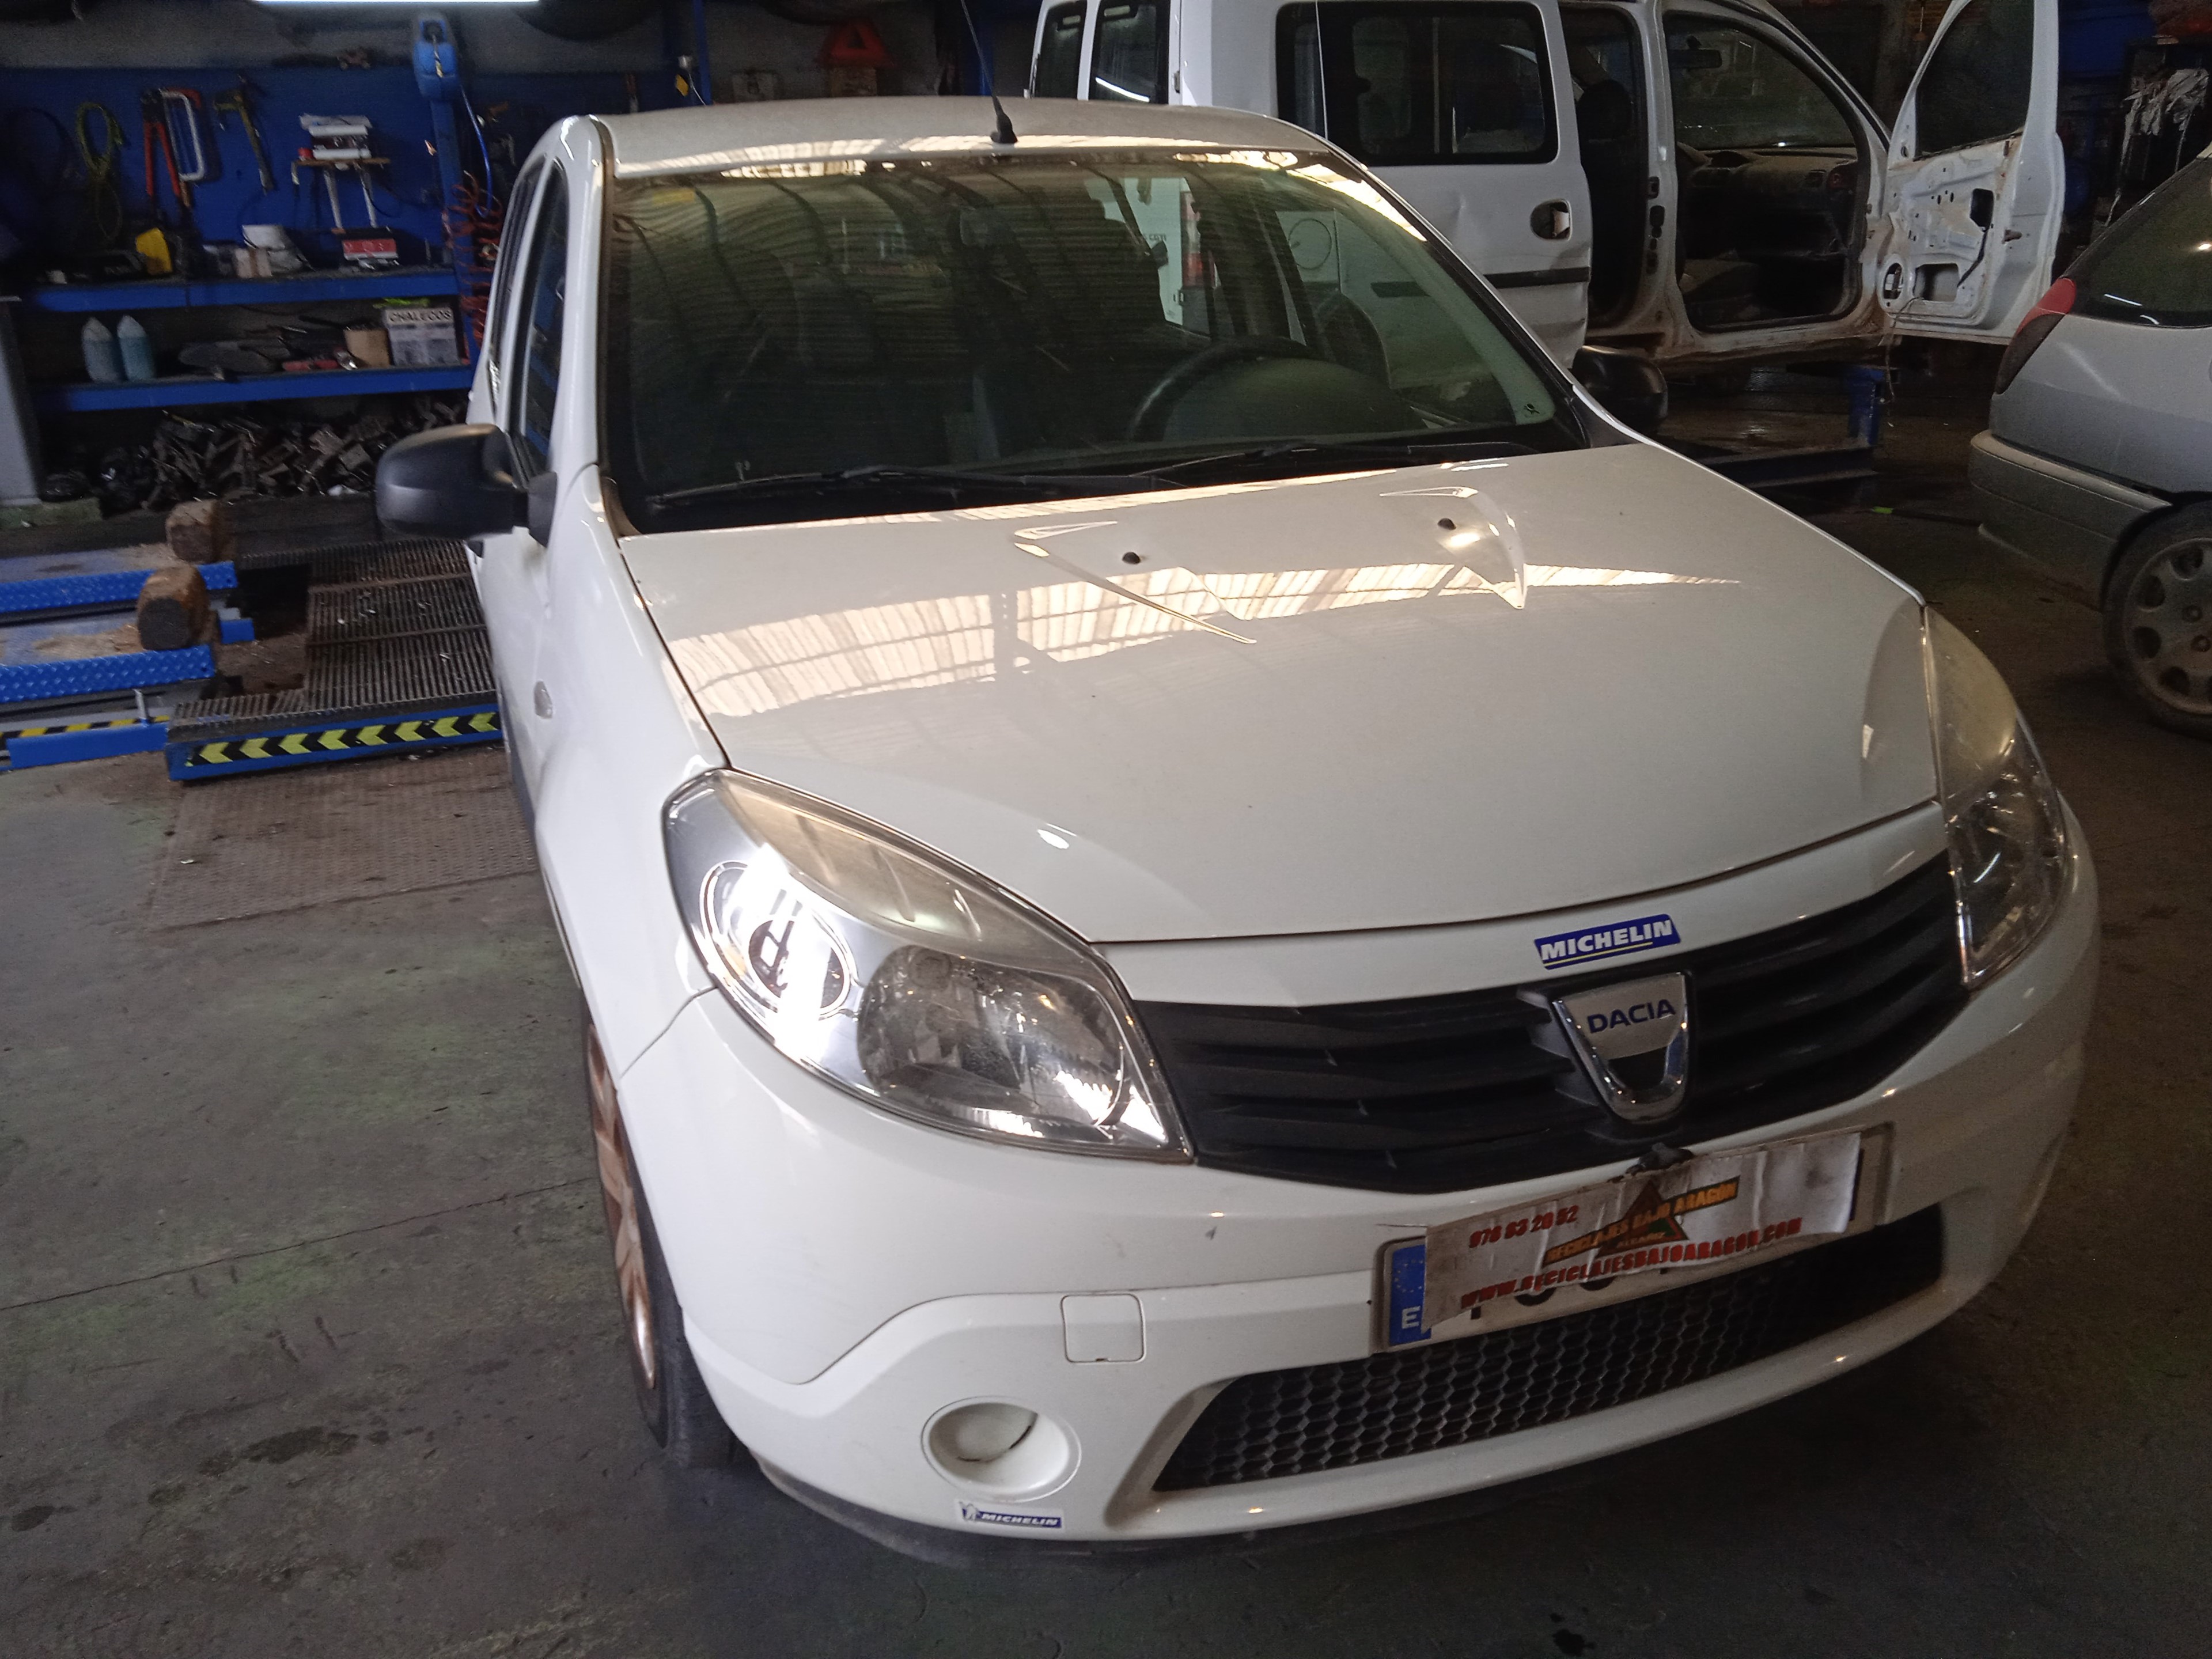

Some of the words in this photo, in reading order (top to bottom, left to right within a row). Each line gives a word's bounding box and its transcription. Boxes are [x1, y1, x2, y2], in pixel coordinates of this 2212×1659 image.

[389, 309, 452, 322] CHALECOS
[1540, 919, 1673, 961] MICHELIN
[1587, 998, 1676, 1033] DACIA
[1402, 1305, 1421, 1329] E
[982, 1513, 1059, 1526] MICHELIN
